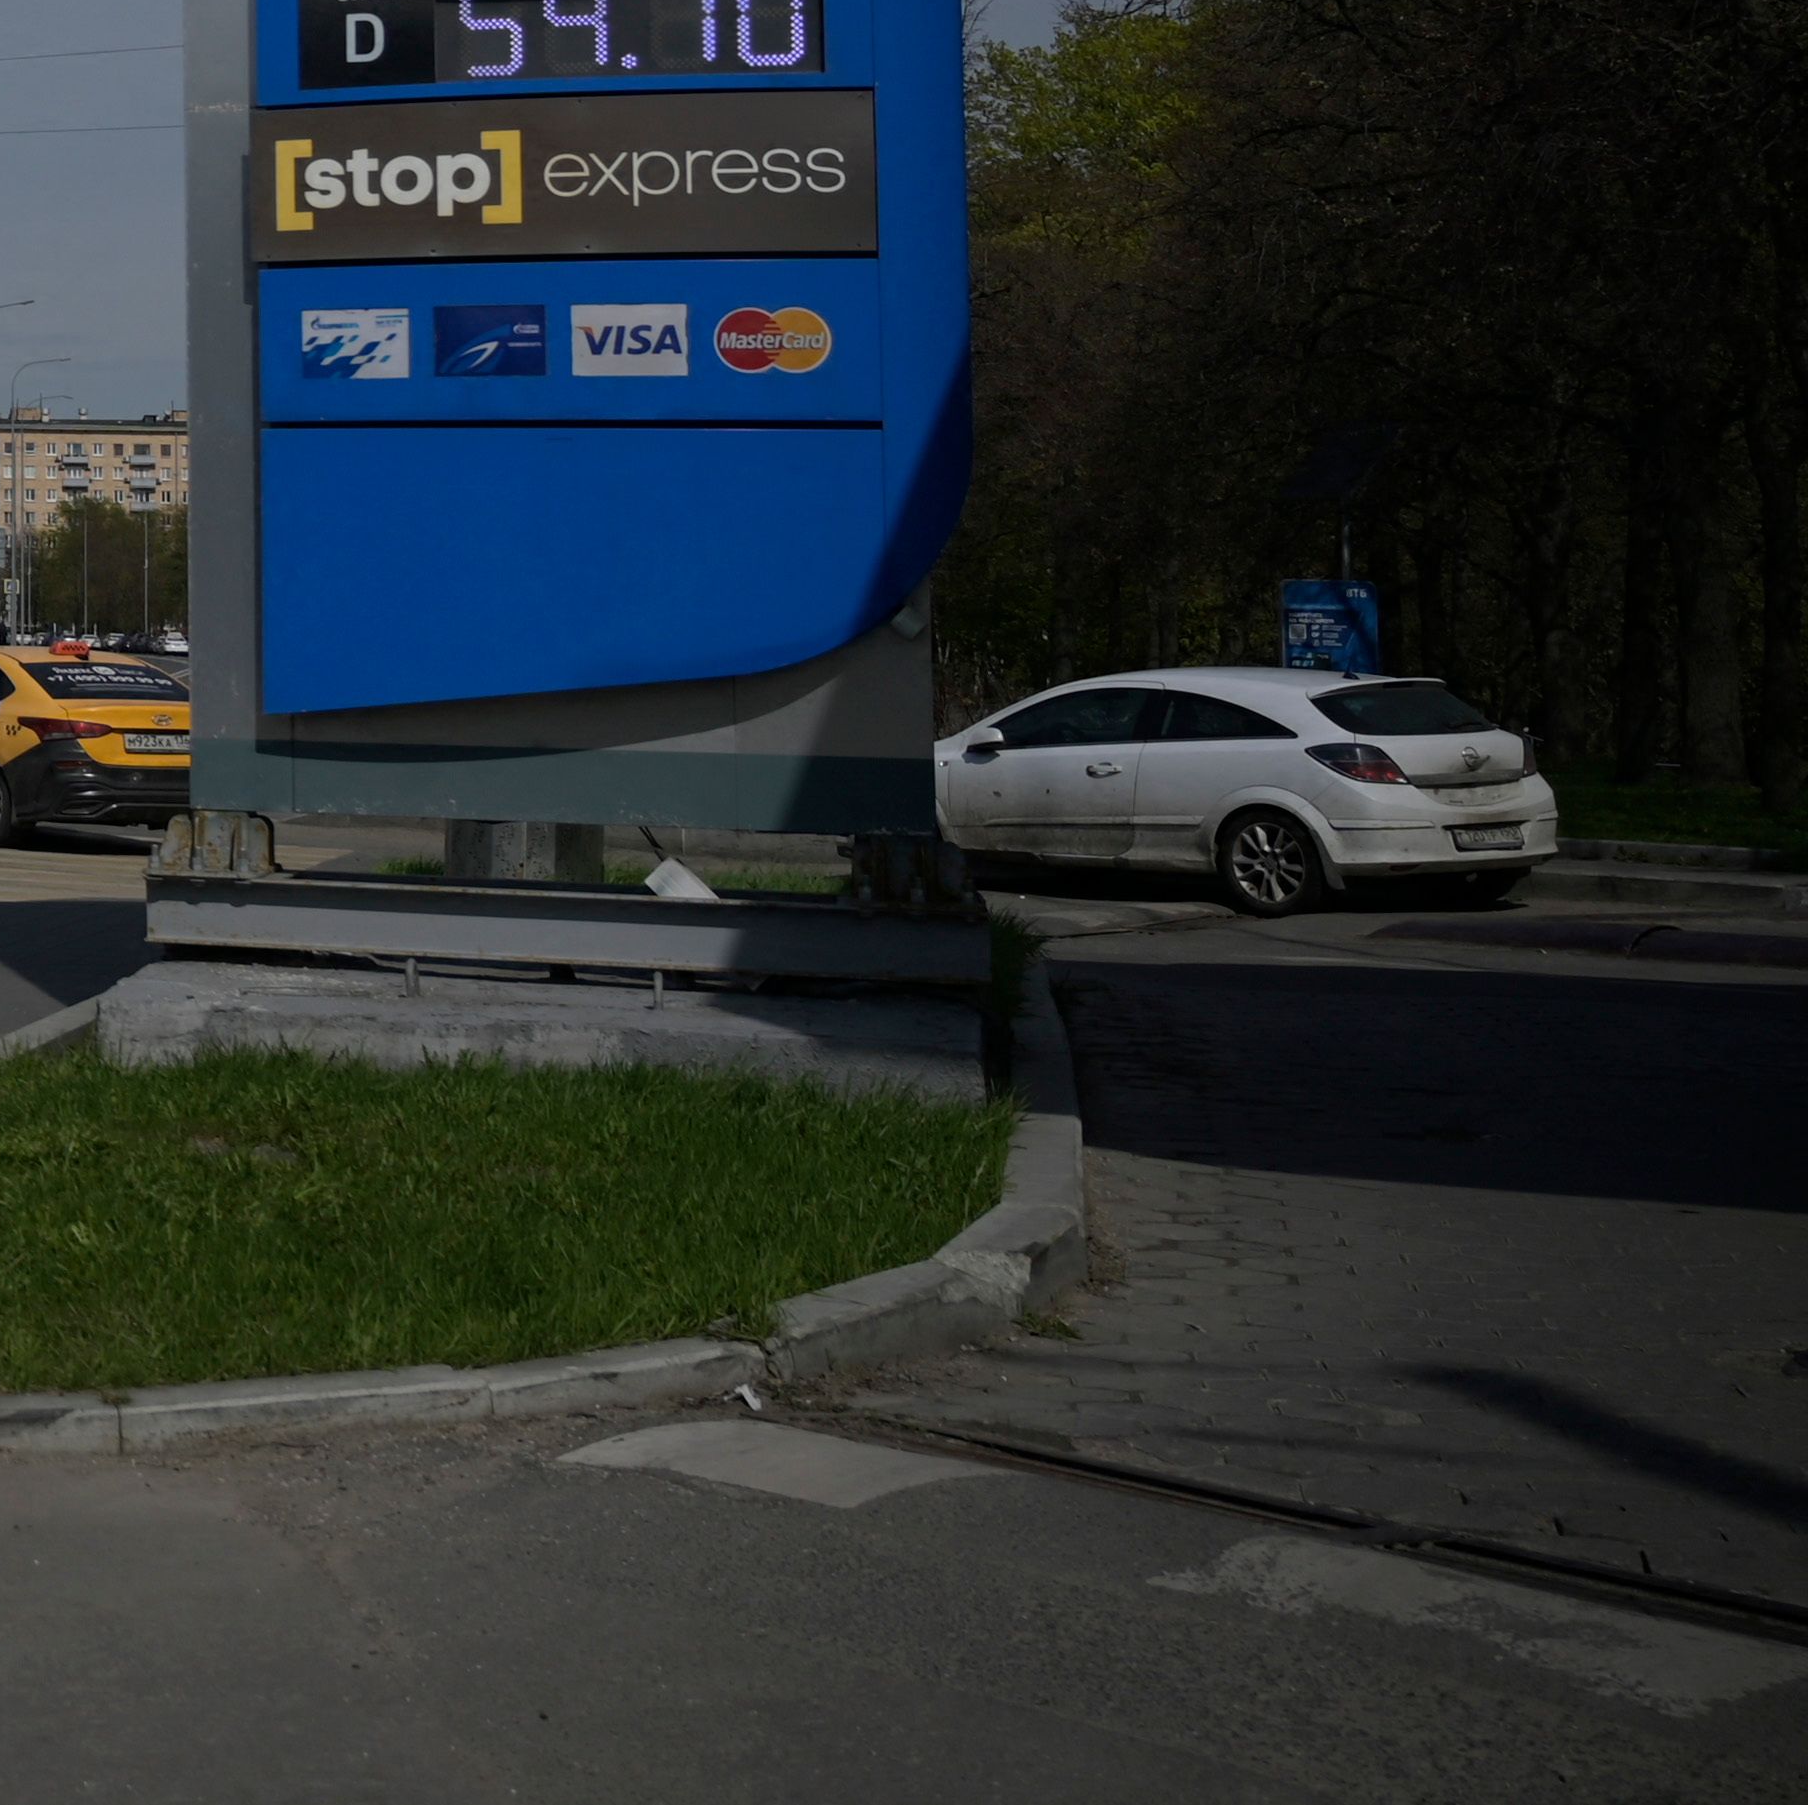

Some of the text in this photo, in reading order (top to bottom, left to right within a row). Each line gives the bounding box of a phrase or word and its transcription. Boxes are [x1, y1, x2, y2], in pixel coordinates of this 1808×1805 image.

[345, 12, 385, 64] D
[542, 145, 847, 208] express
[575, 324, 683, 356] VISA
[718, 329, 826, 351] MasterCard
